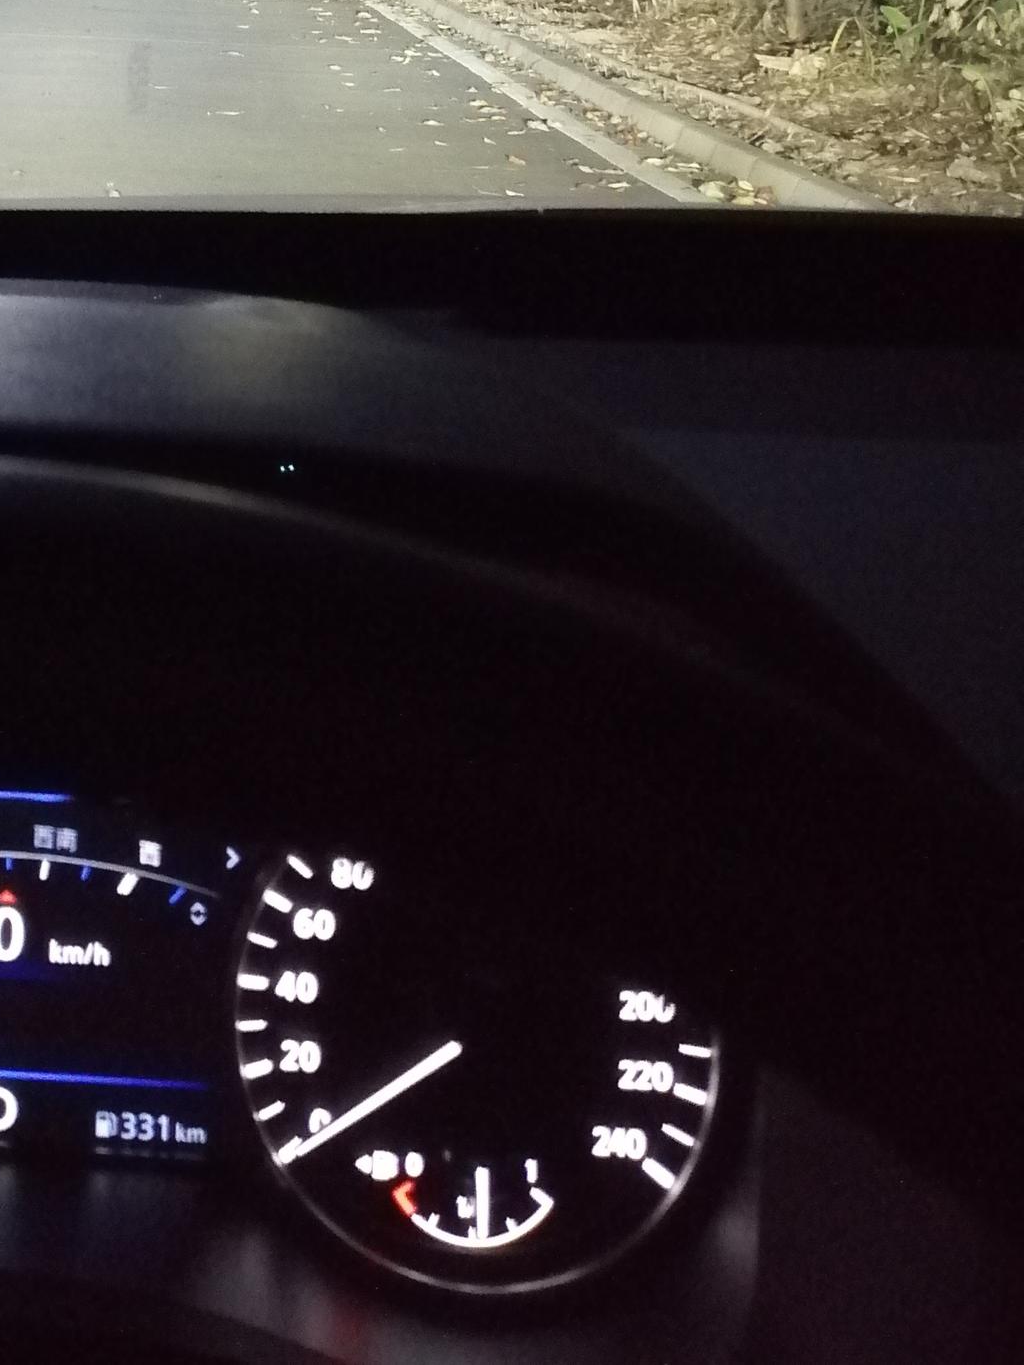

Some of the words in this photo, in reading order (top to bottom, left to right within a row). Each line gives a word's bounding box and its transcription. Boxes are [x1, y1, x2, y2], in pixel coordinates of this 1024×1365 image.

[331, 857, 374, 890] 80
[290, 905, 336, 941] 60
[49, 939, 111, 966] km/h
[274, 970, 319, 1004] 40
[619, 990, 676, 1023] 200
[279, 1039, 322, 1073] 20
[618, 1059, 673, 1093] 220
[592, 1125, 649, 1162] 240
